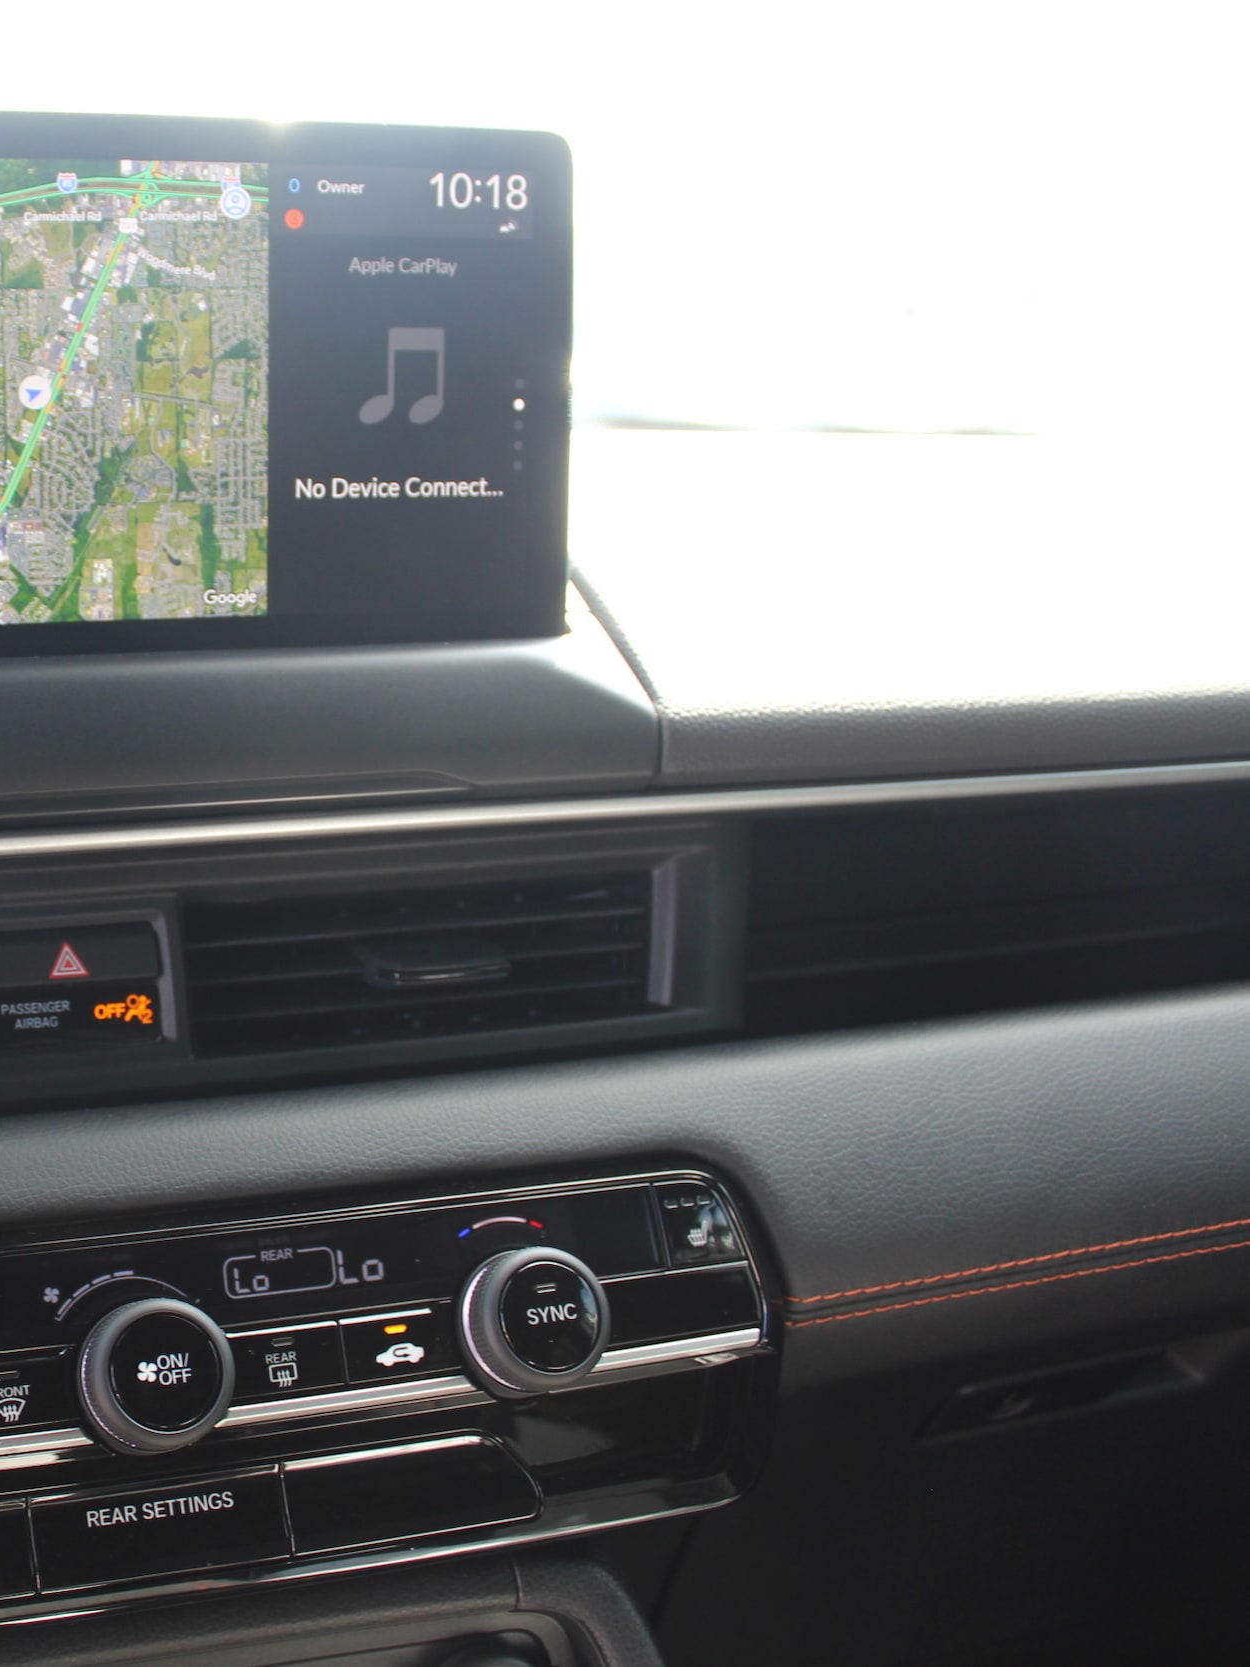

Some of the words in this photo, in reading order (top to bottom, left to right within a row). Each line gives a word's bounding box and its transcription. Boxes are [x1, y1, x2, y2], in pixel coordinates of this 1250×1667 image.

[317, 179, 366, 194] Owner
[430, 172, 528, 210] 10:18
[23, 211, 85, 222] Carmichael
[86, 211, 102, 222] Rd
[139, 211, 201, 222] Carmichael
[203, 211, 218, 222] Rd
[348, 257, 395, 275] Apple
[398, 257, 457, 277] CarPlay
[295, 478, 326, 498] No
[331, 477, 400, 498] Device
[203, 589, 257, 607] Google
[0, 1000, 71, 1015] PASSENGER
[94, 1002, 127, 1020] OFF
[14, 1016, 59, 1030] AIRBAG
[260, 1248, 294, 1262] REAR
[337, 1249, 384, 1285] Lo
[233, 1267, 270, 1294] Lo
[526, 1302, 578, 1326] SYNC
[157, 1352, 190, 1369] ON/
[265, 1351, 297, 1365] REAR
[159, 1368, 192, 1386] OFF
[86, 1505, 137, 1528] REAR
[141, 1491, 235, 1521] SETTINGS
